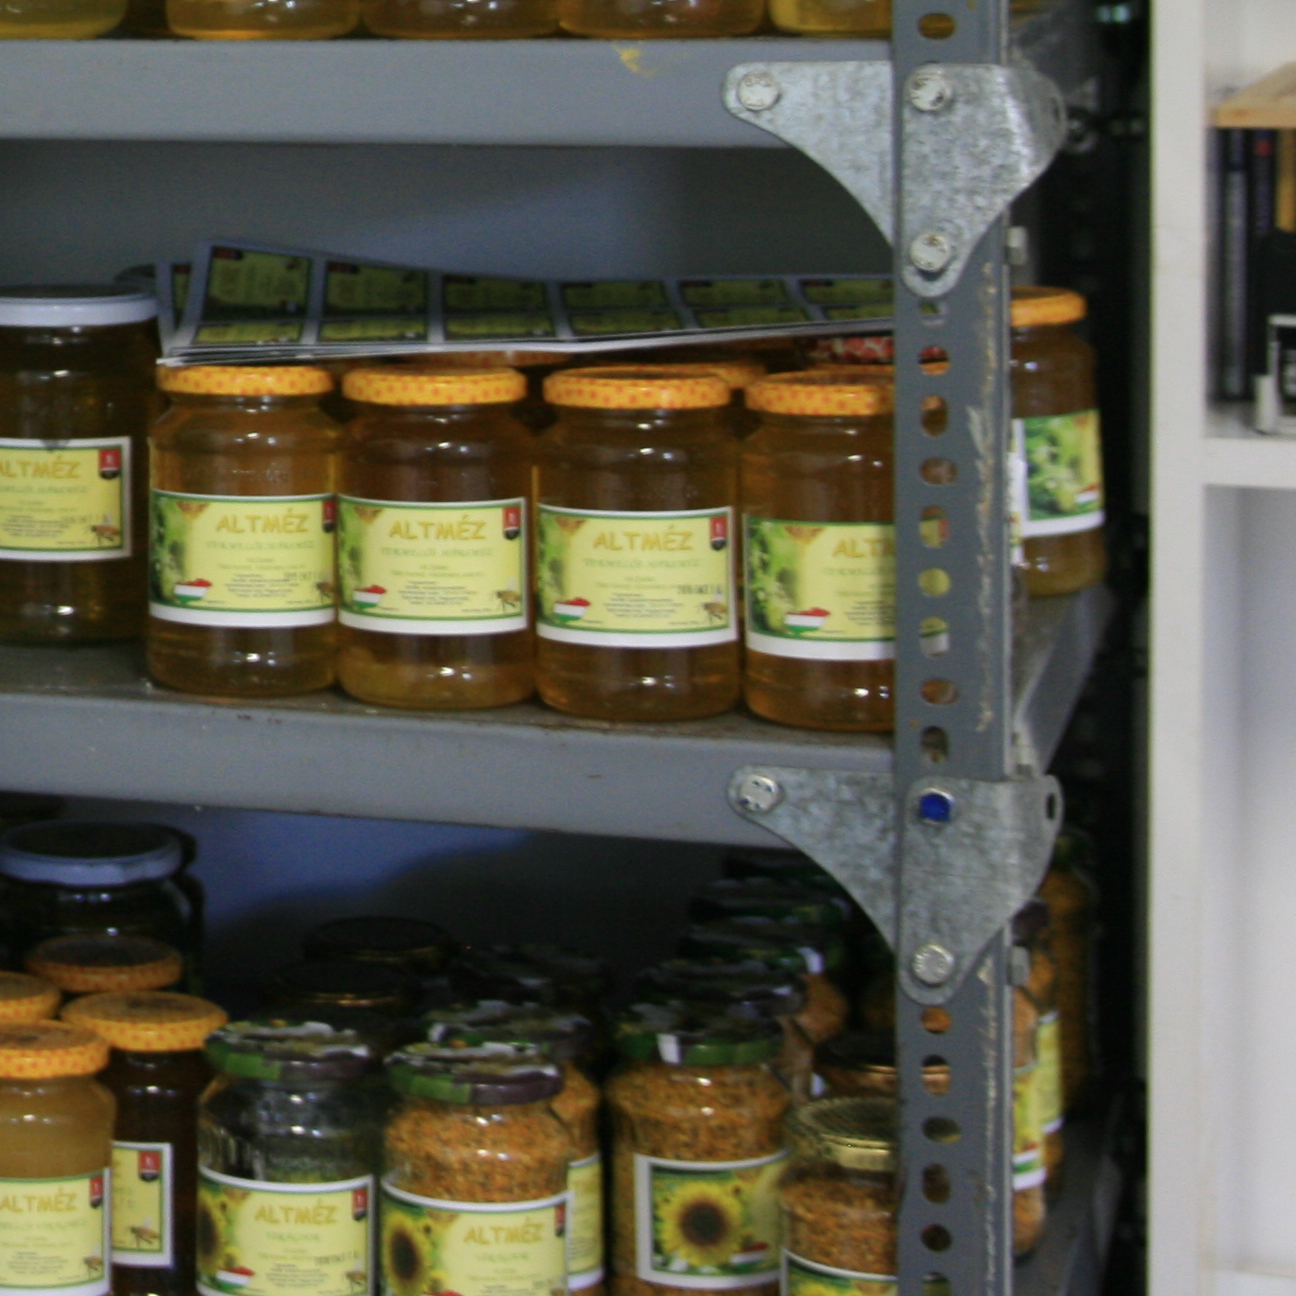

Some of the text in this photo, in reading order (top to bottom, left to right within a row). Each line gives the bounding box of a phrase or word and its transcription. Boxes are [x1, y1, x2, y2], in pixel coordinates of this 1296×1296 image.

[215, 507, 309, 534] ALTMÉZ
[387, 514, 486, 540] ALTMÉZ
[592, 524, 695, 551] ALTMÉZ
[254, 1198, 338, 1225] ALTMÉZ
[463, 1216, 545, 1245] ALTMÉZ
